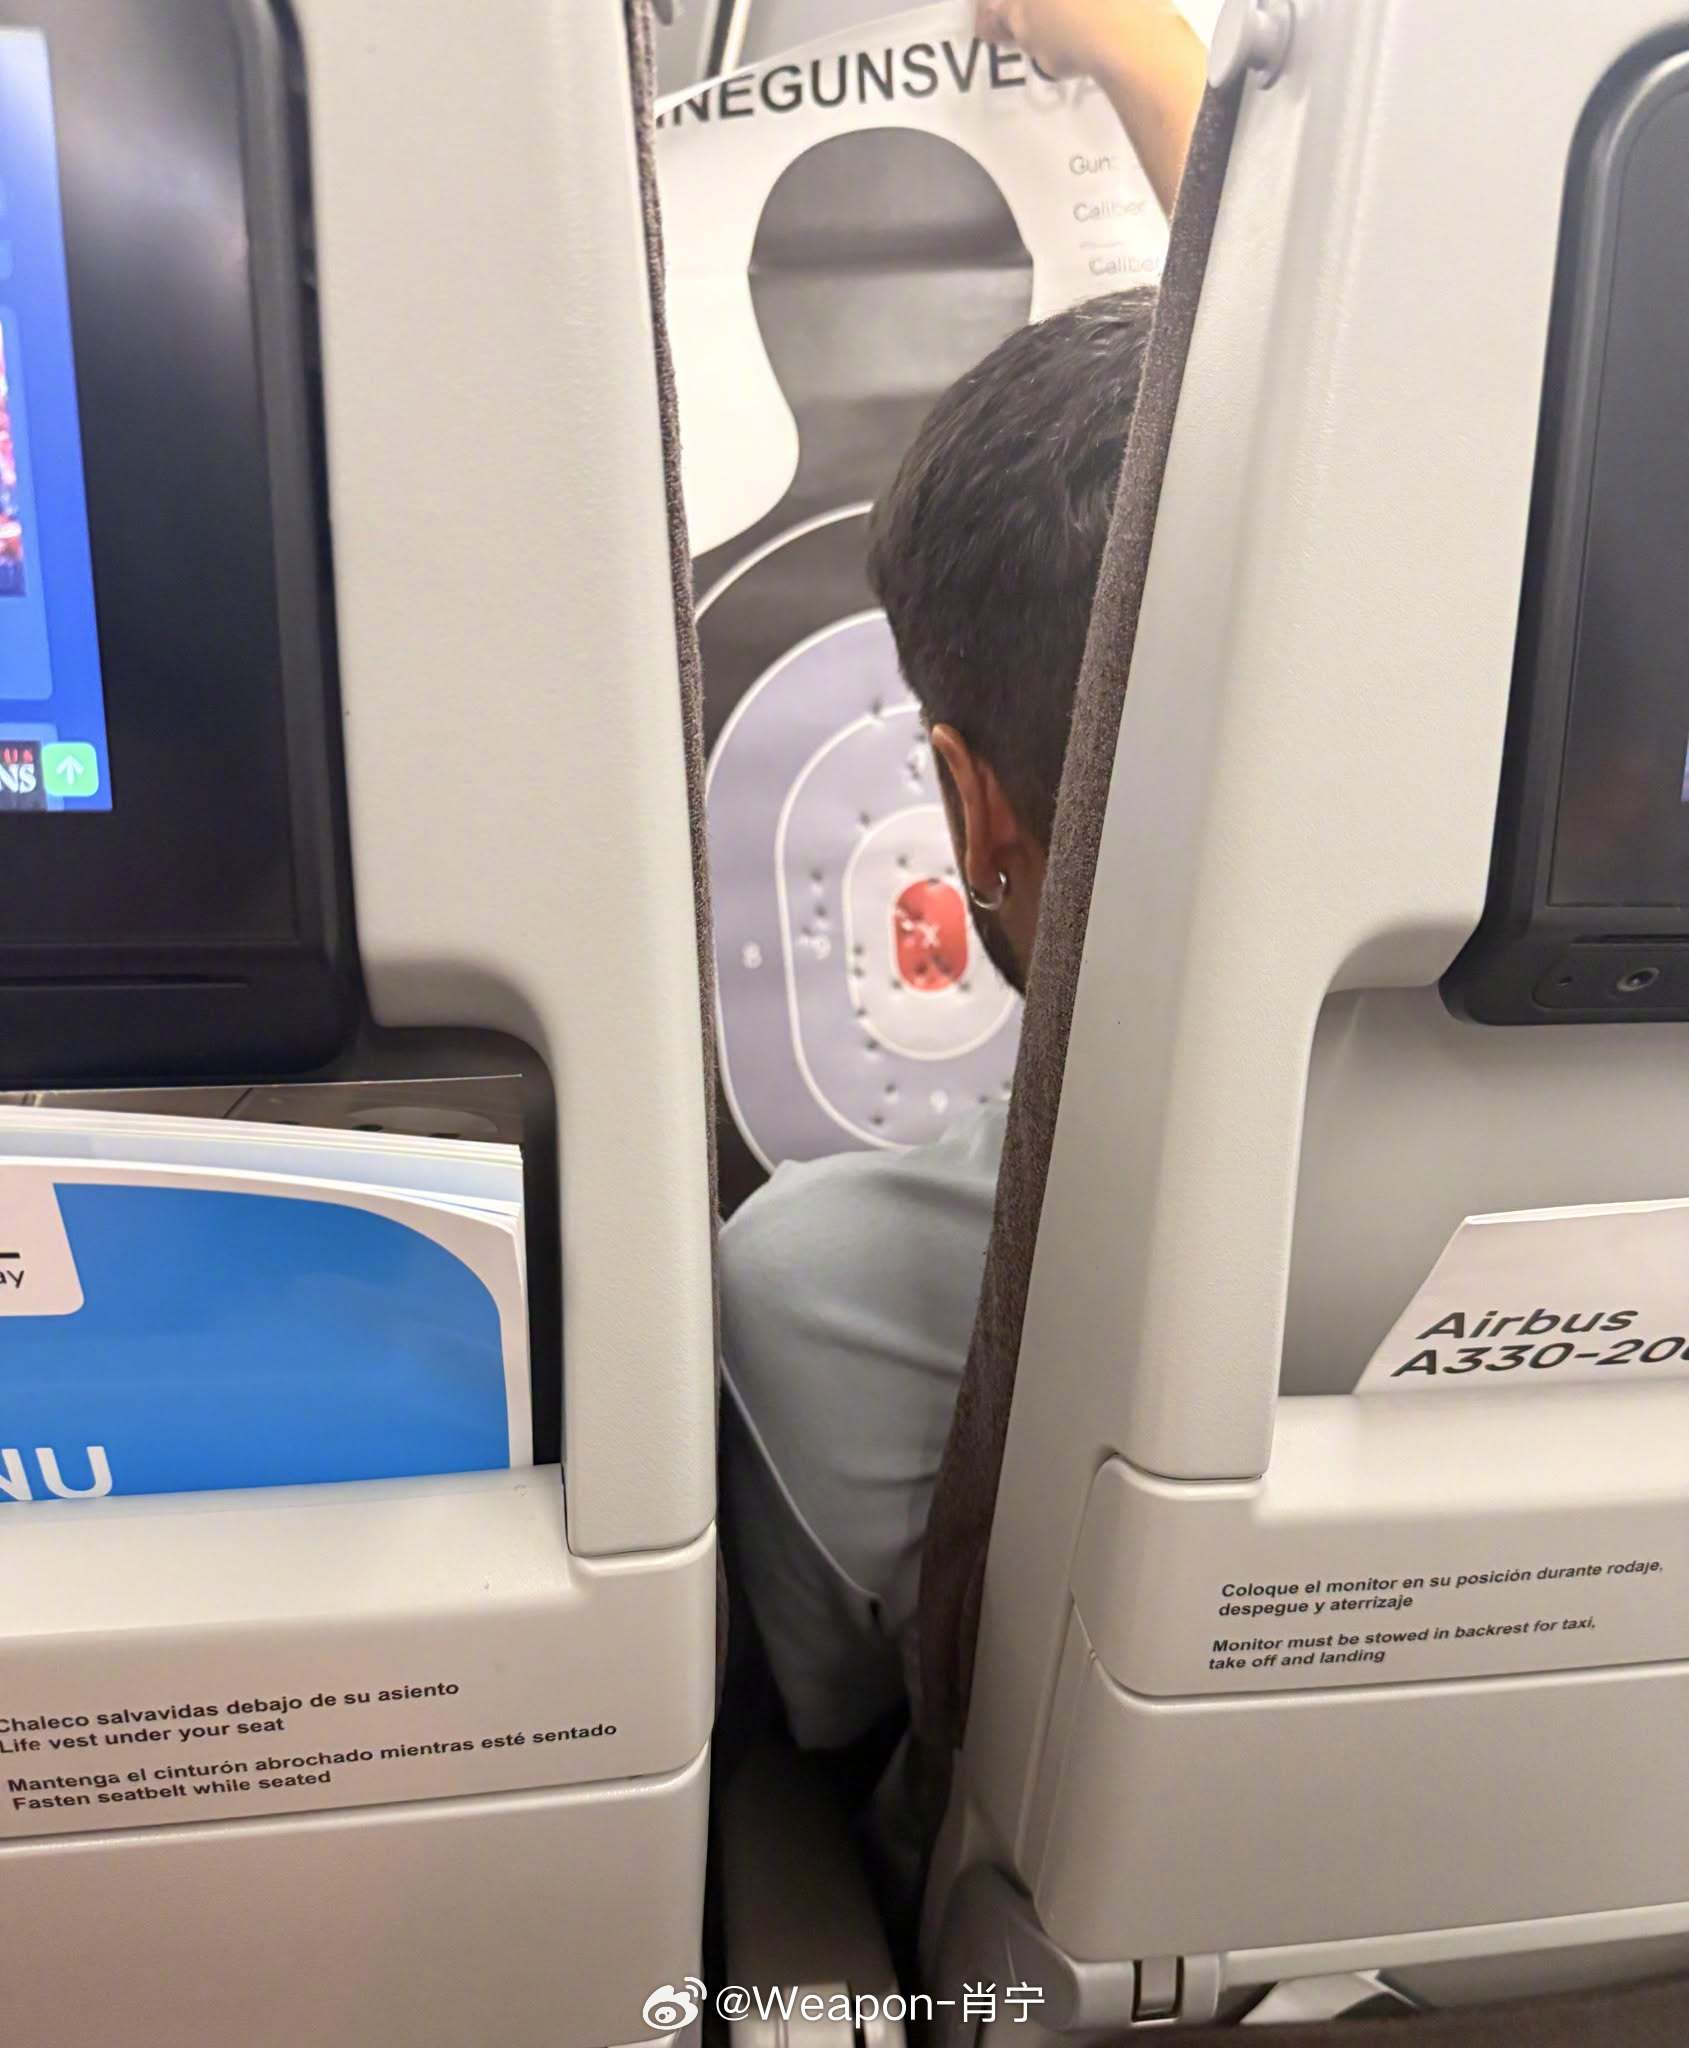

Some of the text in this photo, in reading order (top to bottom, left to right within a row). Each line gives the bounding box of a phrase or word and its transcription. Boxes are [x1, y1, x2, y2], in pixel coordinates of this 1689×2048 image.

[655, 37, 1056, 129] NEGUNSVE
[1415, 1308, 1639, 1340] Airbus
[1389, 1336, 1689, 1377] A330-20
[1221, 1582, 1299, 1598] Coloque
[1304, 1580, 1321, 1595] el
[1326, 1577, 1398, 1593] monitor
[1402, 1576, 1424, 1589] en
[1428, 1575, 1451, 1588] su
[1455, 1568, 1531, 1589] posición
[1536, 1563, 1602, 1580] durante
[1218, 1594, 1414, 1617] despegue y aterrizaje
[1212, 1637, 1283, 1652] Monitor
[1287, 1635, 1333, 1649] must
[1337, 1633, 1360, 1646] be
[1364, 1628, 1430, 1644] stowed
[1433, 1626, 1450, 1640] in
[1454, 1621, 1529, 1639] backrest
[1533, 1618, 1559, 1633] for
[1209, 1649, 1387, 1670] take off and landing
[0, 1682, 459, 1734] Chaleco salvavidas debajo de su asiento
[0, 1717, 286, 1754] Life vest under your seat
[7, 1723, 618, 1793] Mantenga el cinturón abrochado mientras esté sentado
[12, 1770, 332, 1811] Fasten seatbelt while seated
